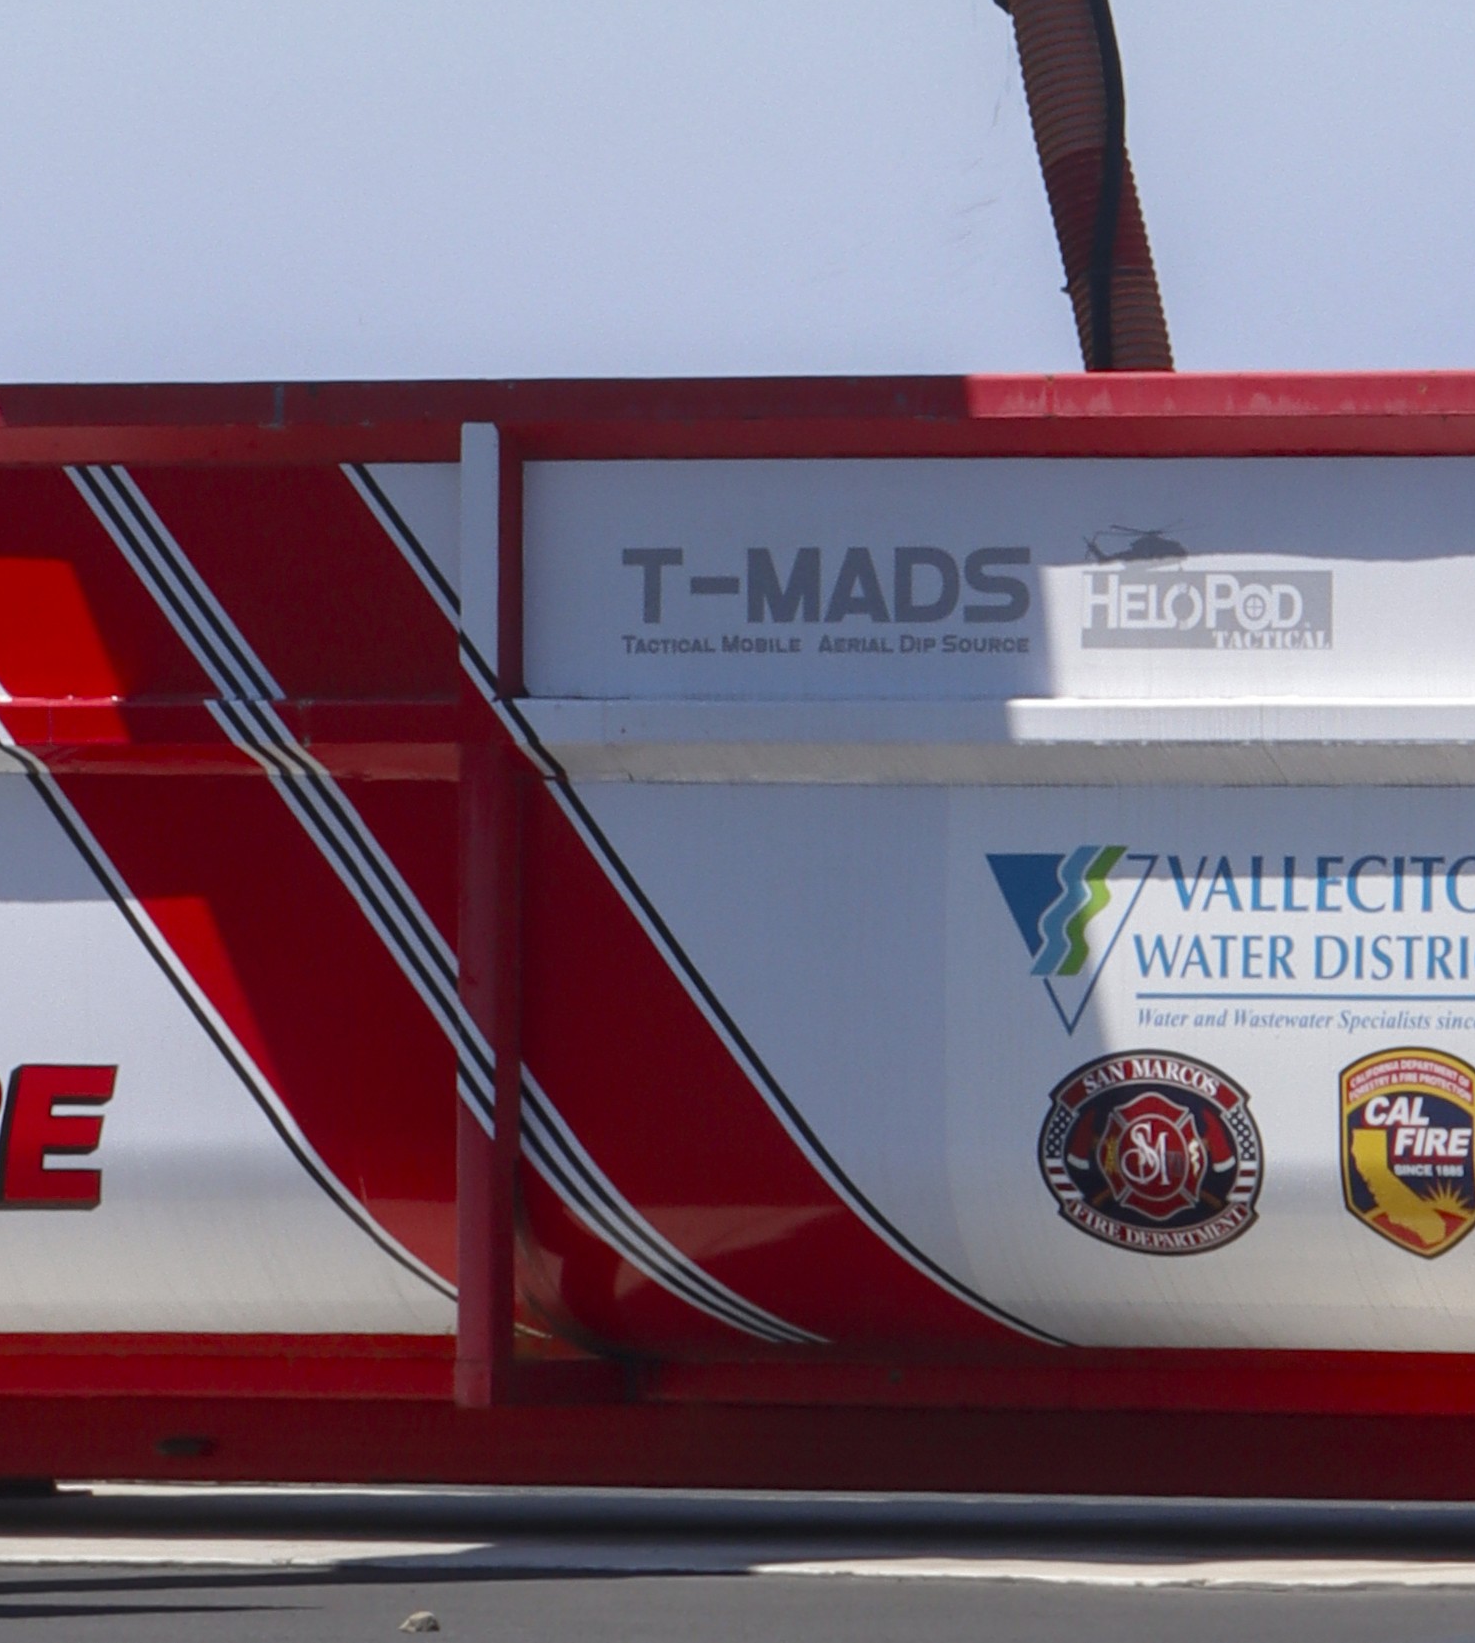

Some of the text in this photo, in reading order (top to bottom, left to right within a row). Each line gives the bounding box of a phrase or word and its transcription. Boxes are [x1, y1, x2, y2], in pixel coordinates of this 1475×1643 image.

[622, 546, 1032, 624] T-MADS
[622, 634, 715, 654] TACTICAL
[722, 634, 802, 654] MOBILE
[818, 634, 895, 654] AERIAL
[941, 634, 1031, 654] SOURCE
[1212, 630, 1331, 650] TACTICAL
[1133, 933, 1296, 979] WATER
[1136, 1008, 1190, 1029] Water
[1193, 1008, 1228, 1028] and
[1232, 1008, 1334, 1029] Wastewater
[1337, 1010, 1431, 1034] Specialists
[1081, 1058, 1221, 1097] SAN MARCOS
[1363, 1096, 1430, 1128] CAL
[1393, 1127, 1473, 1158] FIRE
[1393, 1164, 1434, 1178] SINCE
[1068, 1200, 1249, 1248] FIRE DEPARTMENT
